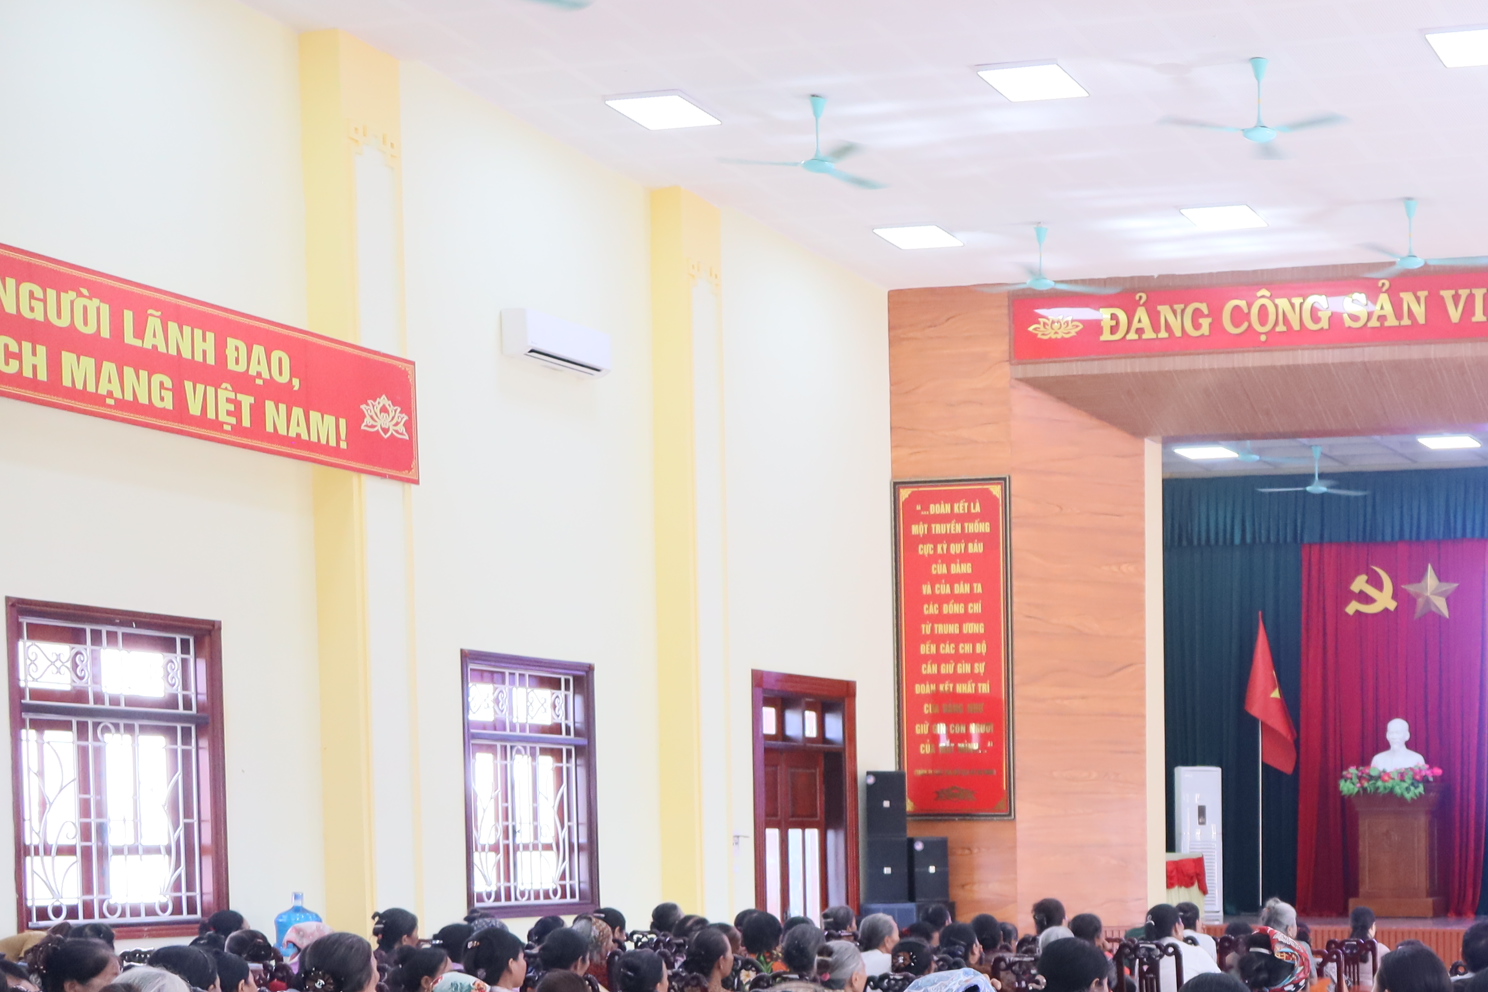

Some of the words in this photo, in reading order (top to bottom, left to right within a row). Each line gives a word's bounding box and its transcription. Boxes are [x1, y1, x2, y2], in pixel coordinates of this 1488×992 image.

[0, 276, 111, 338] NGƯỜI
[123, 309, 216, 365] LÃNH
[226, 337, 300, 391] ĐẠO,
[1100, 292, 1212, 341] ĐẢNG
[1221, 288, 1330, 342] CỘNG
[1342, 280, 1428, 328] SẢN
[62, 350, 174, 411] MẠNG
[184, 380, 255, 432] VIỆT
[265, 403, 348, 449] NAM!
